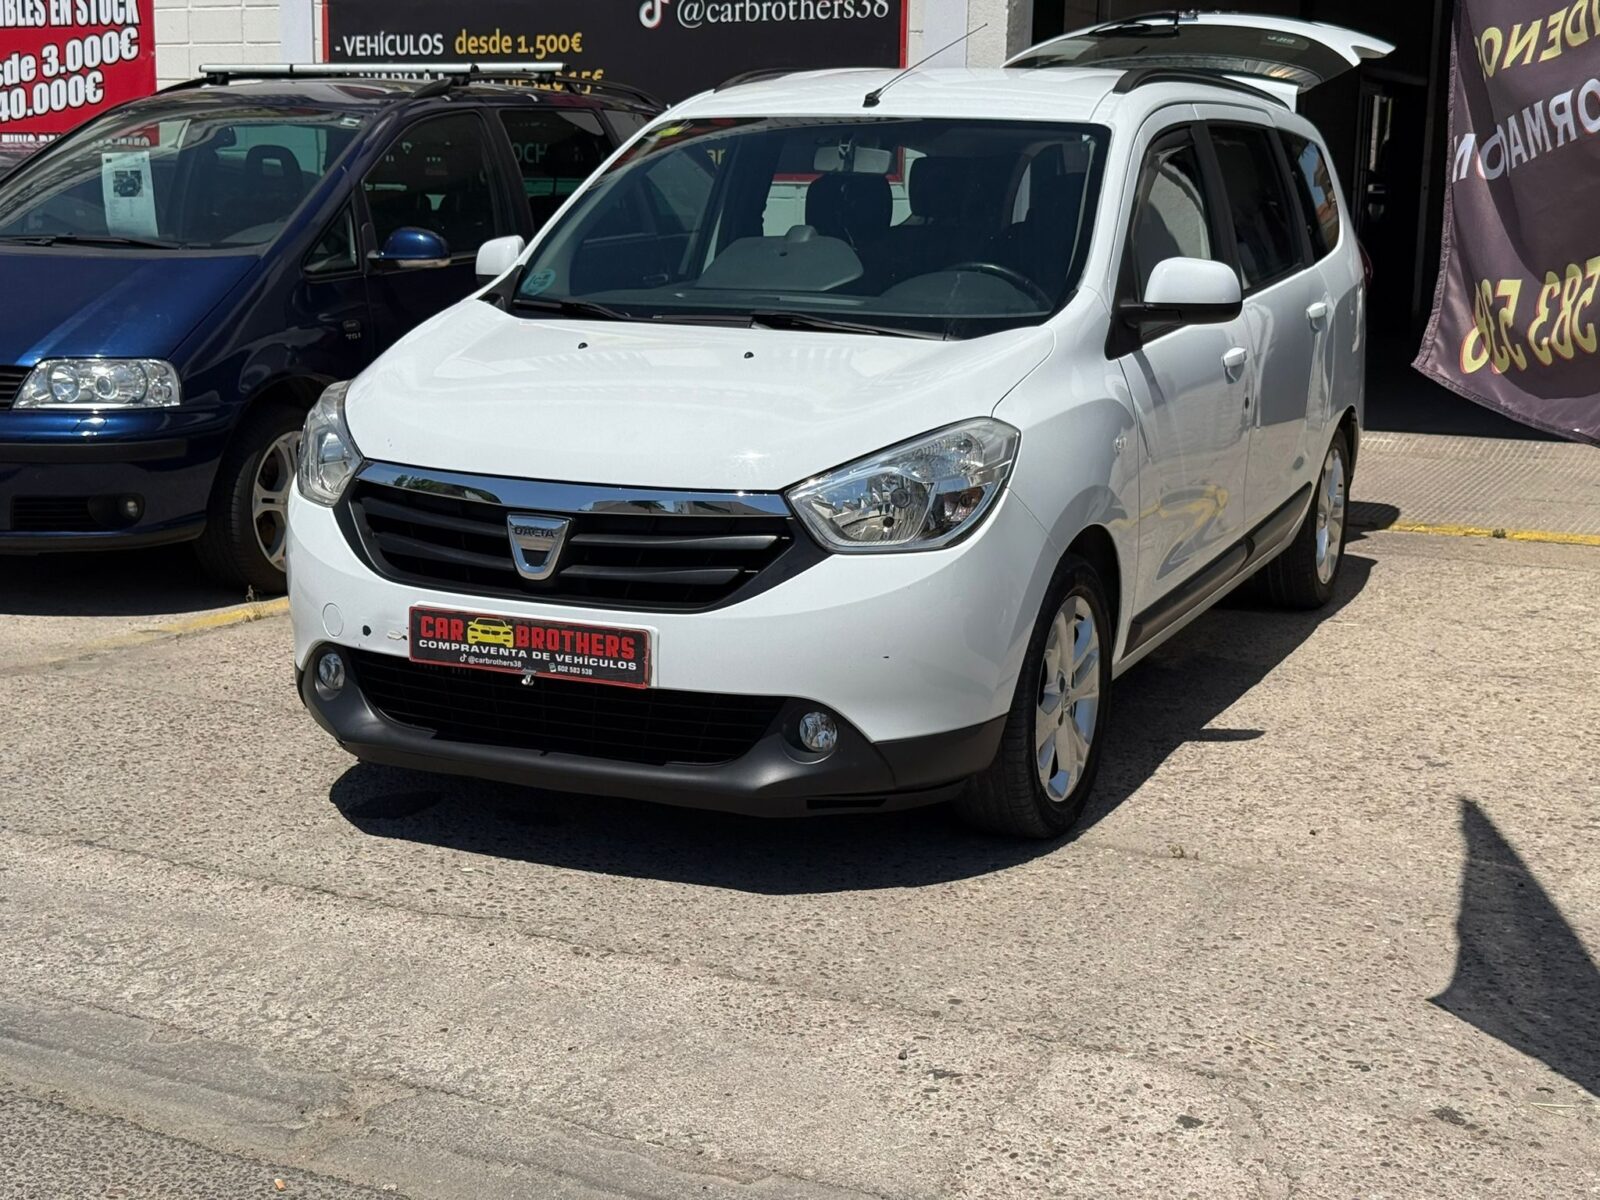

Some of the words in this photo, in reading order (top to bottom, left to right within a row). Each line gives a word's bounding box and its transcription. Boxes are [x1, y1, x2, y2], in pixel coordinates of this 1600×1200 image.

[50, 0, 72, 26] EN
[75, 0, 140, 26] STOCK
[0, 53, 36, 86] de
[41, 26, 139, 77] 3.000€
[455, 28, 512, 54] desde
[517, 32, 583, 60] 1.500€
[0, 71, 104, 122] 40.000€
[514, 526, 555, 538] DACIA
[420, 615, 464, 641] CAR
[515, 625, 635, 659] BROTHERS
[419, 640, 527, 658] COMPRAVENTA
[532, 651, 551, 661] DE
[555, 653, 637, 671] VEHÍCULOS
[468, 656, 522, 668] @carbrothers38
